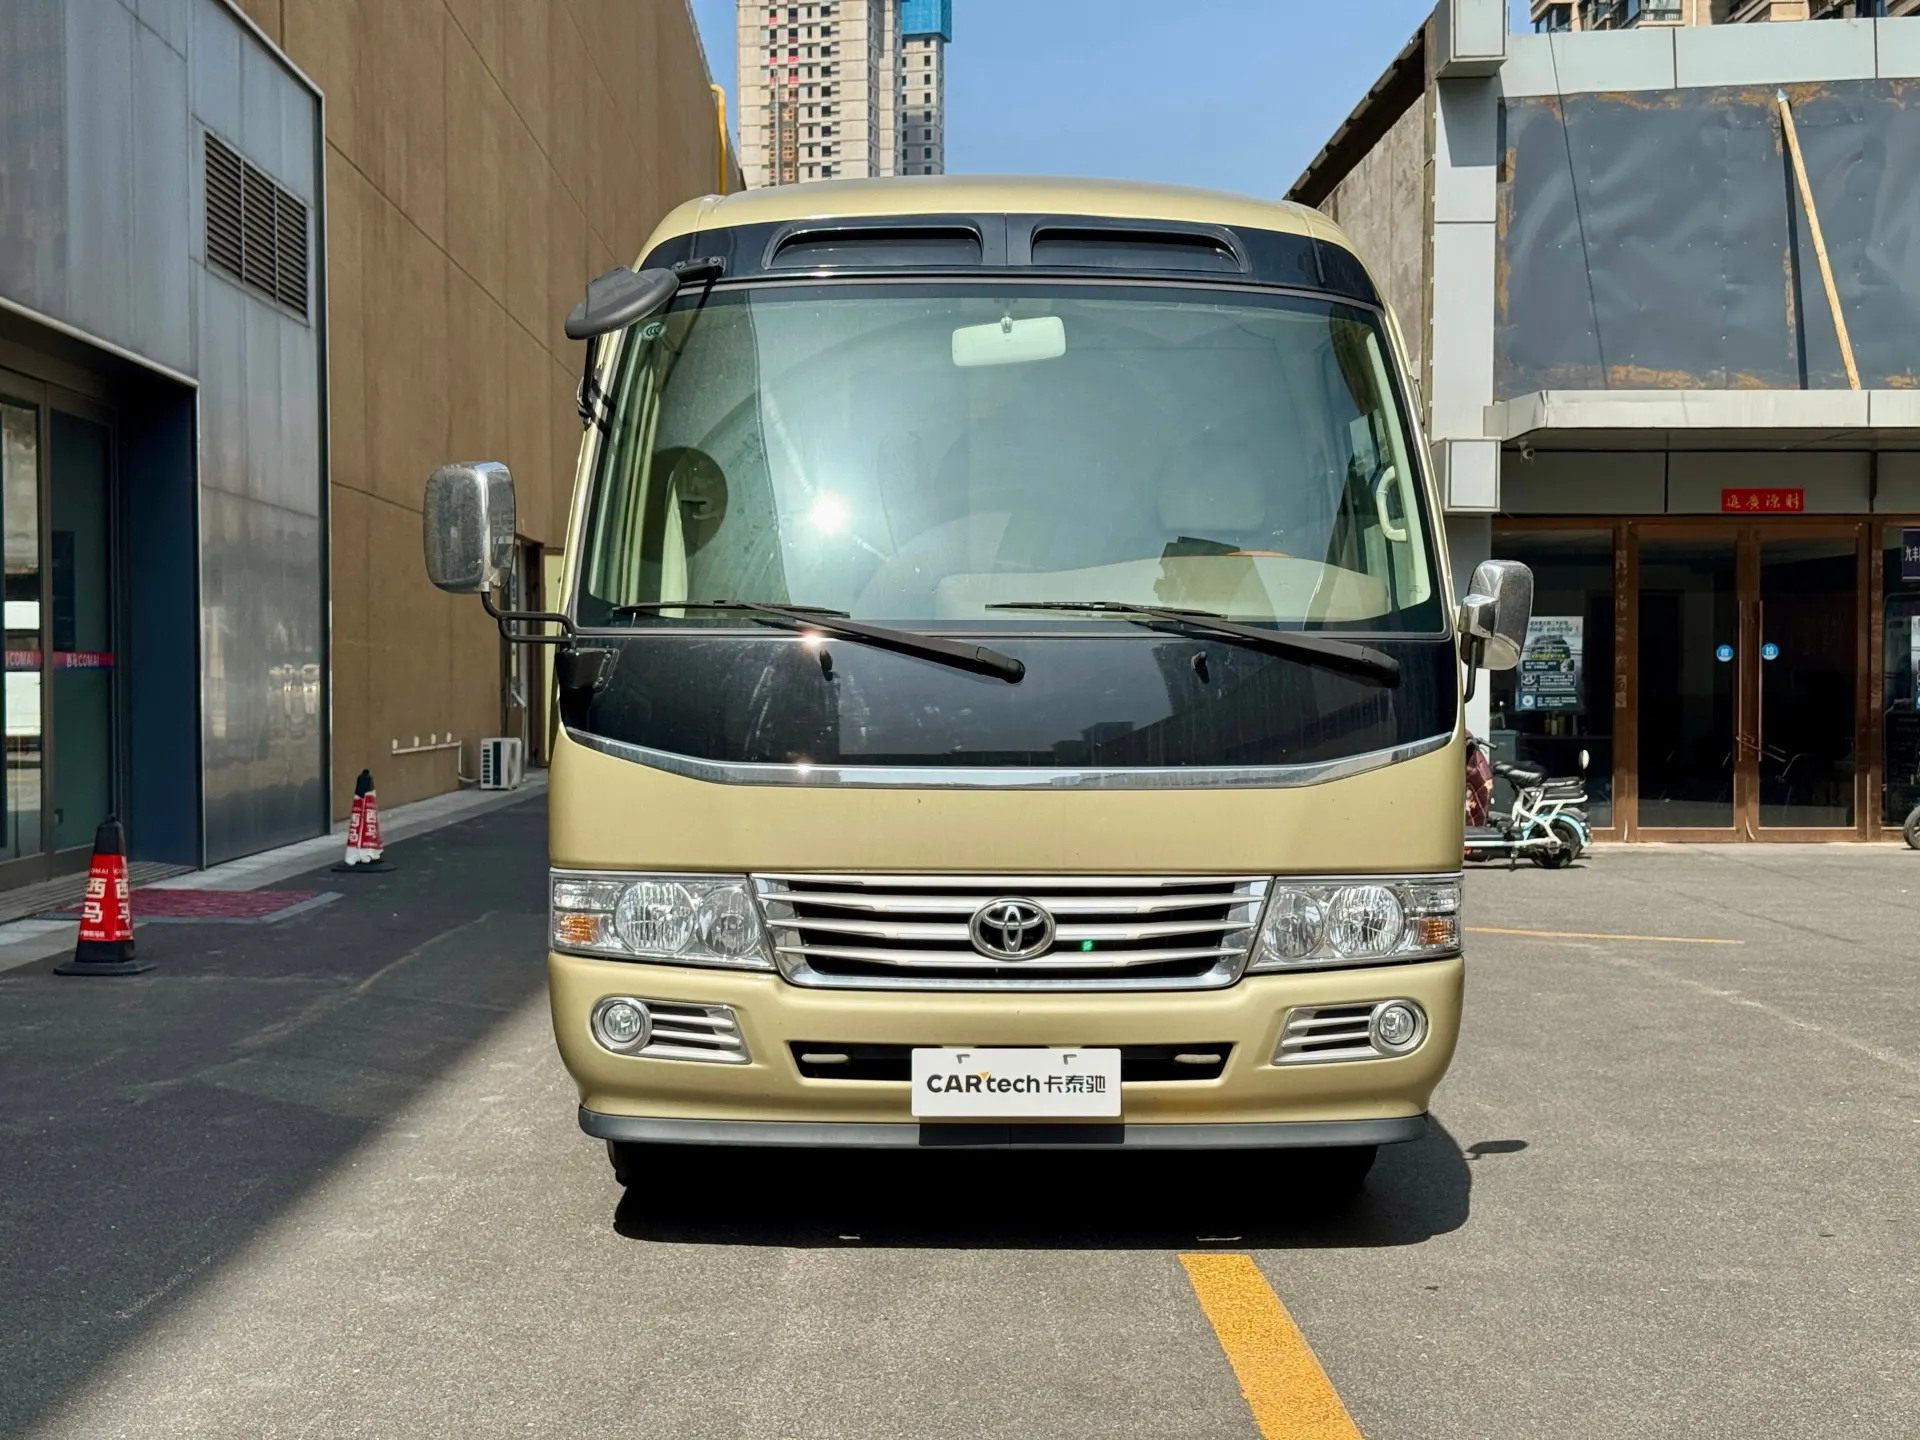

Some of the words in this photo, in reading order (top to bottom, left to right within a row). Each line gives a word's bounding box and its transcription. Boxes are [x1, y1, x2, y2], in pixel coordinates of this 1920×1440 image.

[926, 1073, 1040, 1093] CARtech
[1043, 1074, 1106, 1094] 卡泰驰
